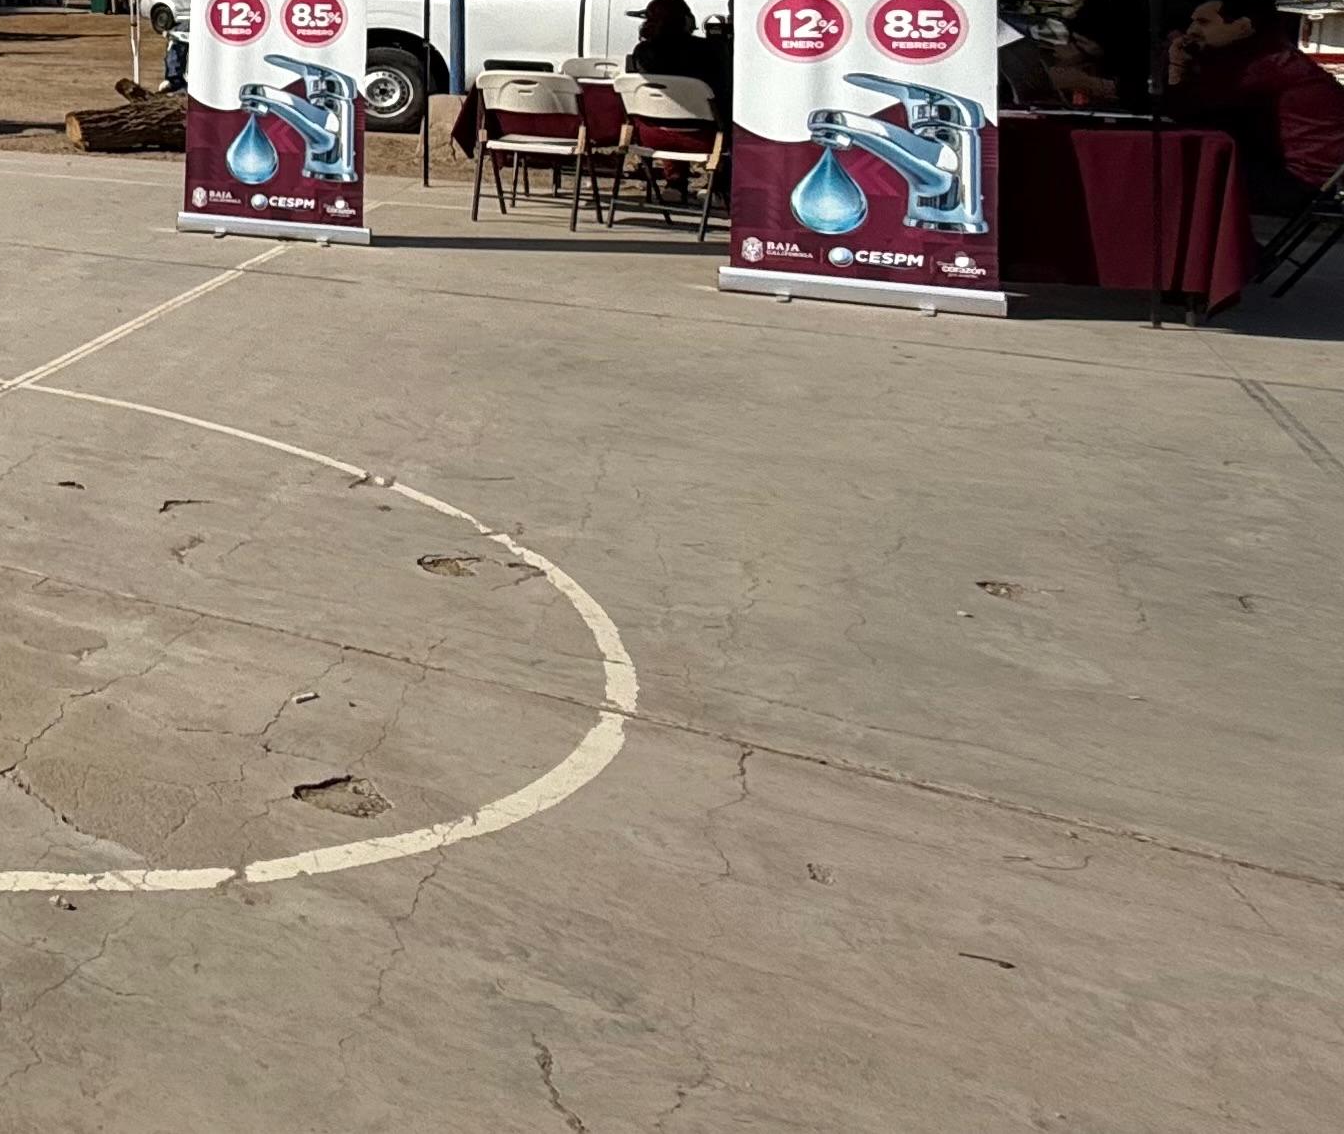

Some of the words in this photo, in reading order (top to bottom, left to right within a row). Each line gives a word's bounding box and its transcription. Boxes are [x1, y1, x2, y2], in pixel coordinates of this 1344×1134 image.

[217, 1, 261, 26] 12%
[291, 3, 342, 27] 8.5%
[773, 8, 839, 38] 12%
[883, 9, 959, 39] 8.5%
[782, 40, 824, 49] ENERO
[891, 41, 947, 50] FEBRERO
[209, 190, 232, 199] BAJA
[269, 196, 314, 209] CESPM
[766, 241, 801, 252] BAJA
[855, 250, 924, 267] CESPM
